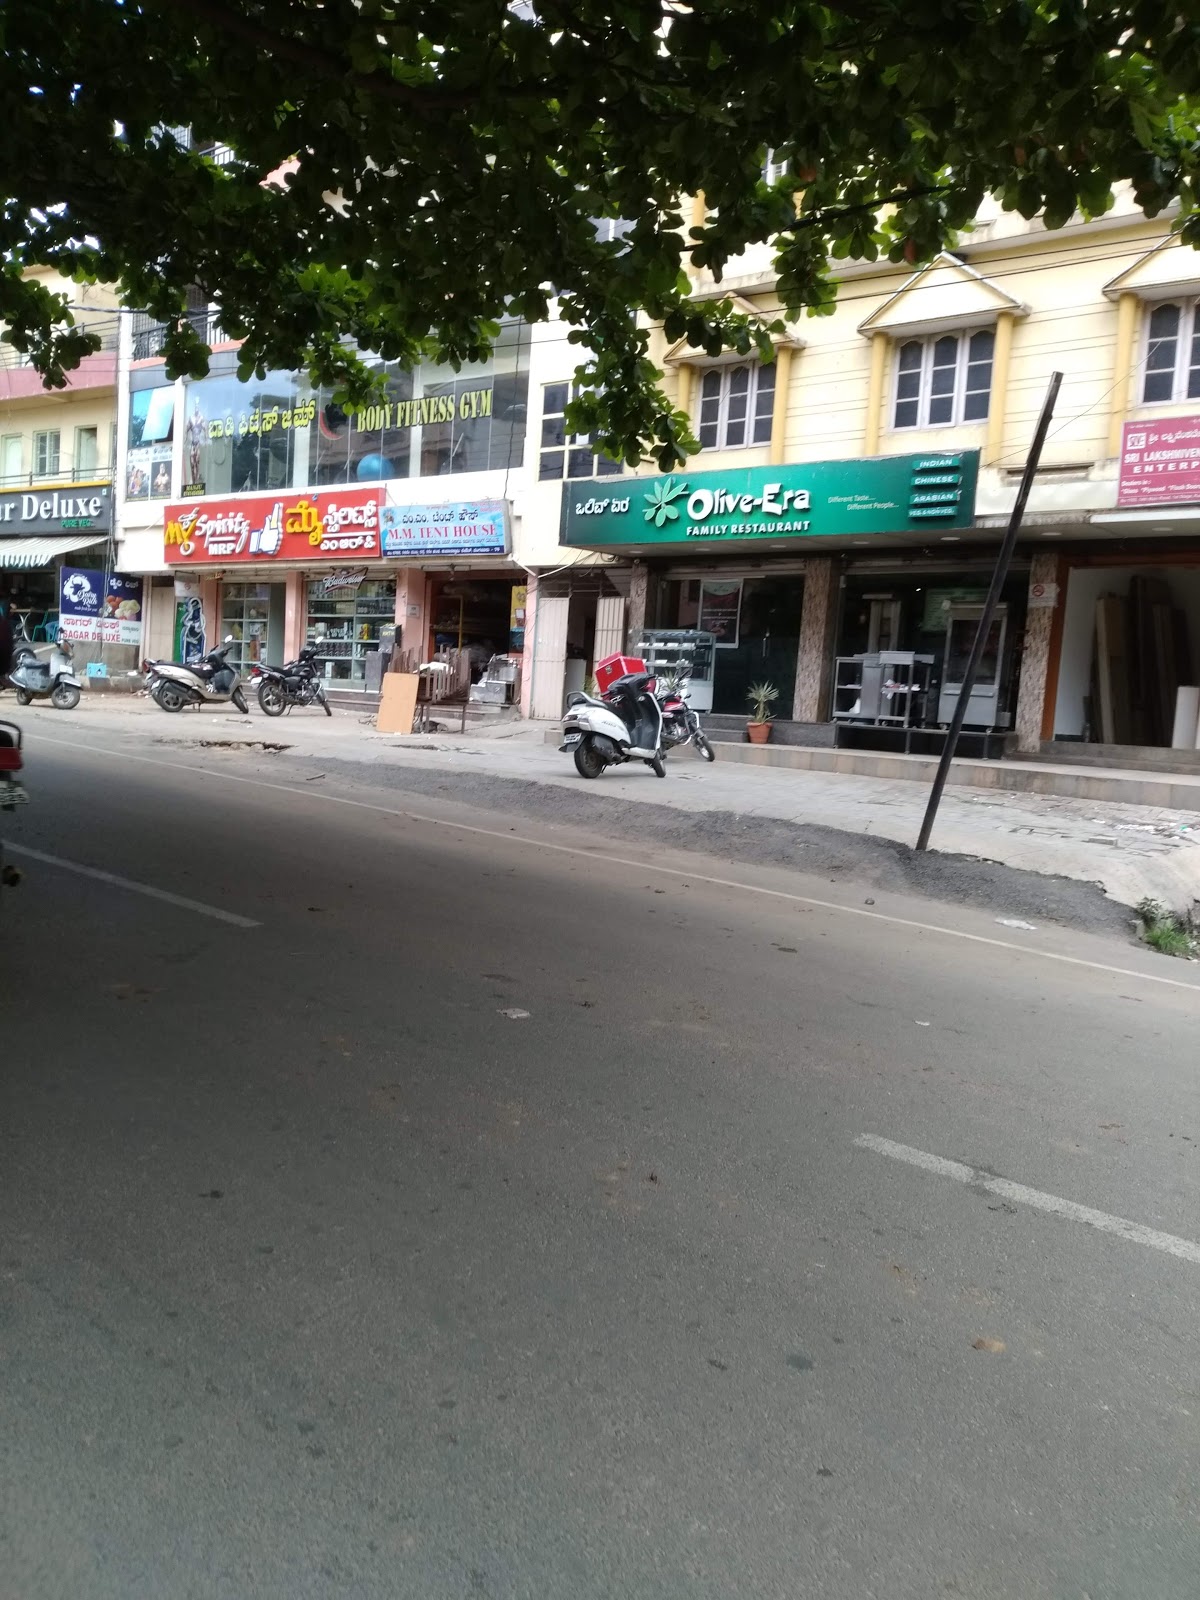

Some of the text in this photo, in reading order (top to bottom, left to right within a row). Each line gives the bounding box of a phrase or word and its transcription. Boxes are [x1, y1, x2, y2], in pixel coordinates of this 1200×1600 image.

[396, 394, 455, 428] FITNESS
[459, 389, 493, 420] GYM
[919, 458, 953, 468] INDIAN
[914, 475, 954, 485] CHINESE
[686, 482, 811, 521] Olive-Era
[913, 492, 954, 503] ARABIAN
[20, 492, 103, 520] Deluxe
[388, 523, 497, 541] M.M. TENT HOUSE
[686, 520, 811, 536] FAMILY RESTAURANT
[208, 542, 236, 556] MRP
[63, 629, 121, 643] SAGAR DELUXE
